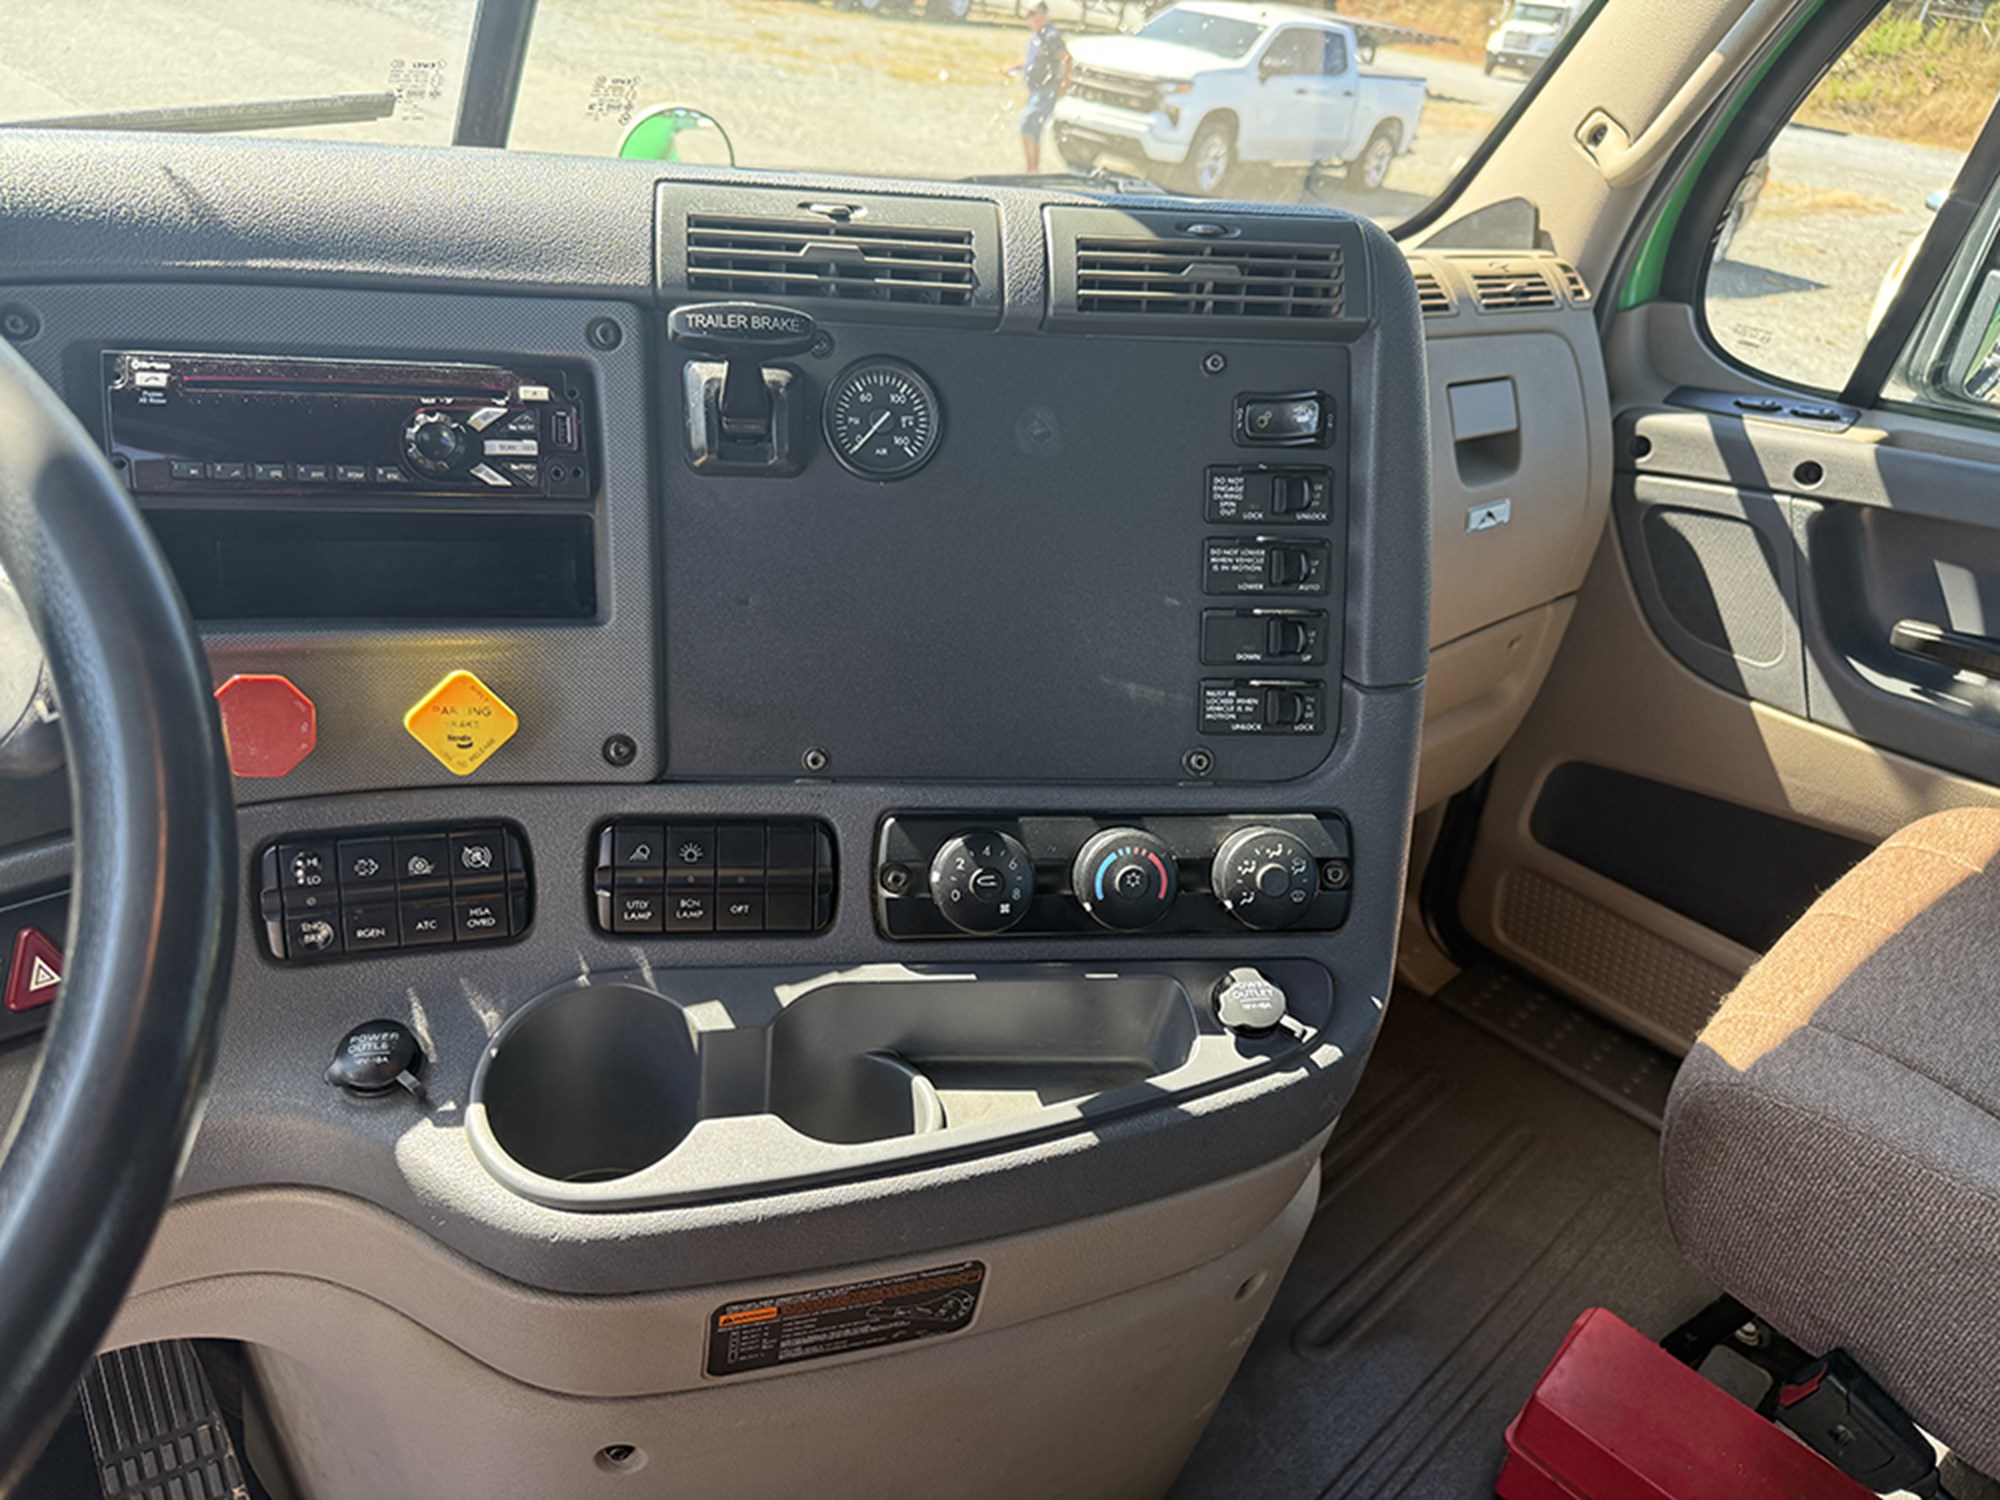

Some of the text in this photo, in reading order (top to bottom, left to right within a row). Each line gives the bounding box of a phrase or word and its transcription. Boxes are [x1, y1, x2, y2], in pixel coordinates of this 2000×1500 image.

[686, 313, 800, 332] TRAILER BRAKE
[859, 392, 873, 403] 60
[889, 393, 907, 404] 100
[1213, 476, 1244, 485] DO NOT
[1212, 493, 1244, 501] DURING
[1219, 508, 1236, 517] OUT
[1242, 511, 1264, 520] LOCK
[1296, 512, 1328, 521] UNLOCK
[1210, 548, 1265, 557] DO NOT LOWER
[1237, 582, 1264, 591] LOWER
[1299, 583, 1321, 591] AUTO
[1235, 653, 1262, 661] DOWN
[432, 704, 492, 718] PARING
[1231, 722, 1262, 731] UNLOCK
[1293, 724, 1315, 732] LOCK
[982, 845, 991, 857] 4
[955, 857, 966, 871] 2
[1008, 856, 1018, 871] 6
[306, 875, 321, 886] LO
[950, 889, 962, 902] 0
[1011, 887, 1022, 901] 8
[680, 899, 700, 909] BCN
[730, 905, 750, 914] OPT
[623, 912, 652, 921] LAMP
[676, 910, 703, 919] LAMP
[415, 919, 438, 930] ATC
[356, 927, 386, 939] RGEN
[349, 1031, 399, 1044] POWER
